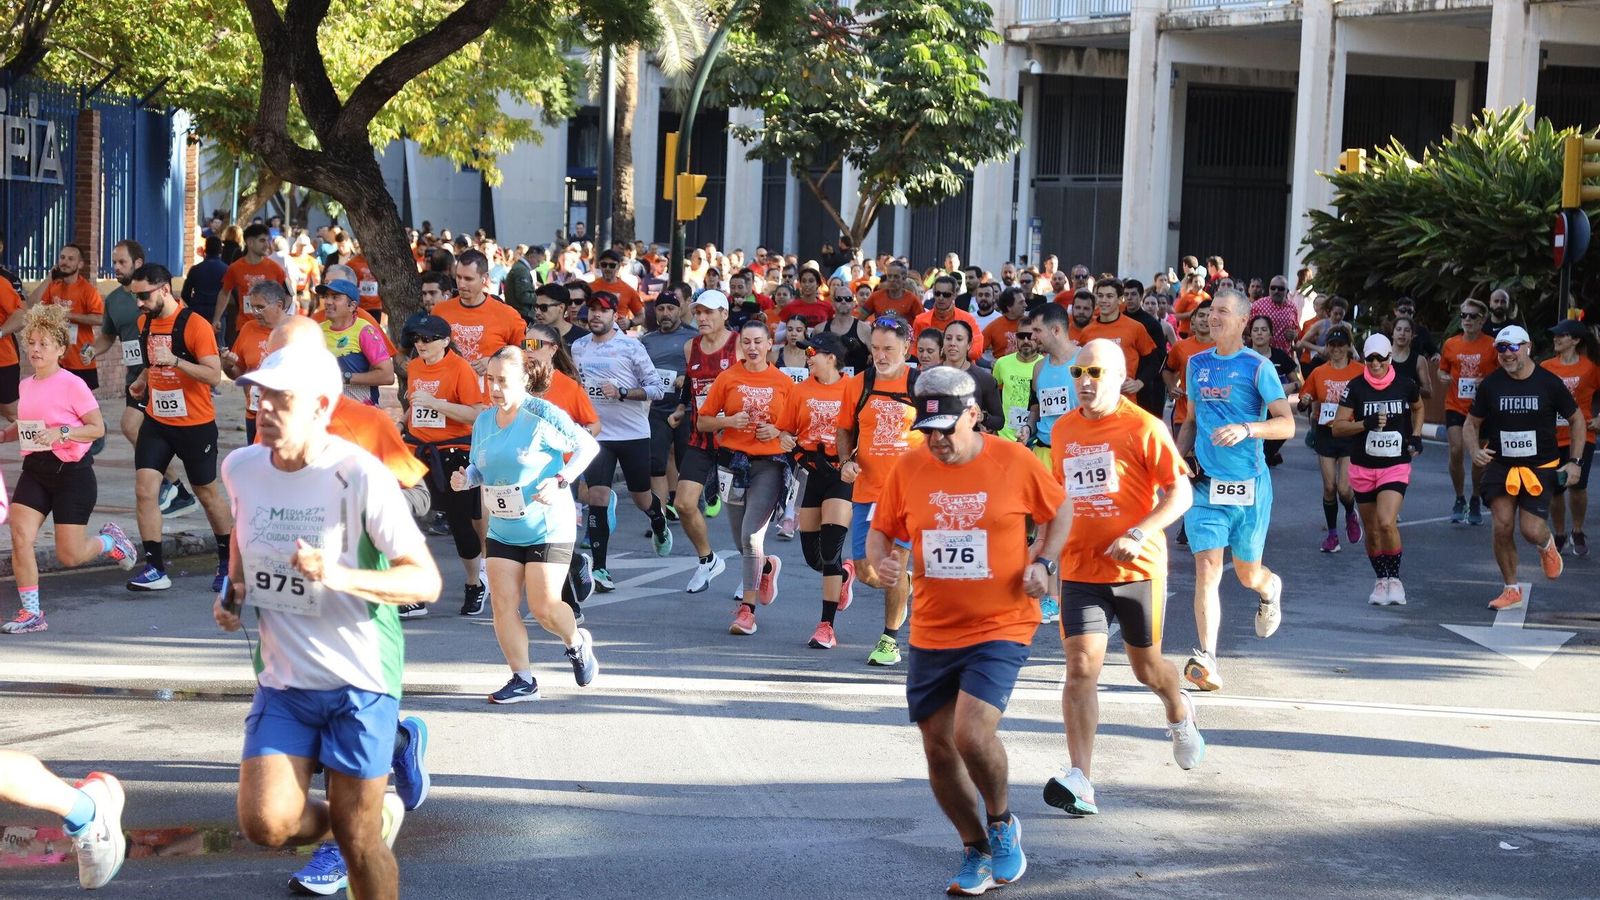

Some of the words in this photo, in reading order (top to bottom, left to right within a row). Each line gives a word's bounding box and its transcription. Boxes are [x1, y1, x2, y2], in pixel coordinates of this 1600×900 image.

[1462, 384, 1477, 392] 27
[156, 400, 178, 410] 103
[1042, 396, 1067, 406] 1018
[1500, 397, 1539, 411] FITCLUB
[1363, 401, 1403, 416] FITLUB
[416, 409, 438, 419] 378
[21, 431, 41, 440] 106
[1370, 440, 1399, 448] 1054
[1504, 440, 1533, 449] 1086
[1074, 468, 1107, 485] 119
[1216, 484, 1246, 496] 963
[496, 498, 507, 509] 8
[266, 532, 290, 542] CIUDAD
[932, 547, 974, 564] 176
[255, 571, 305, 596] 975
